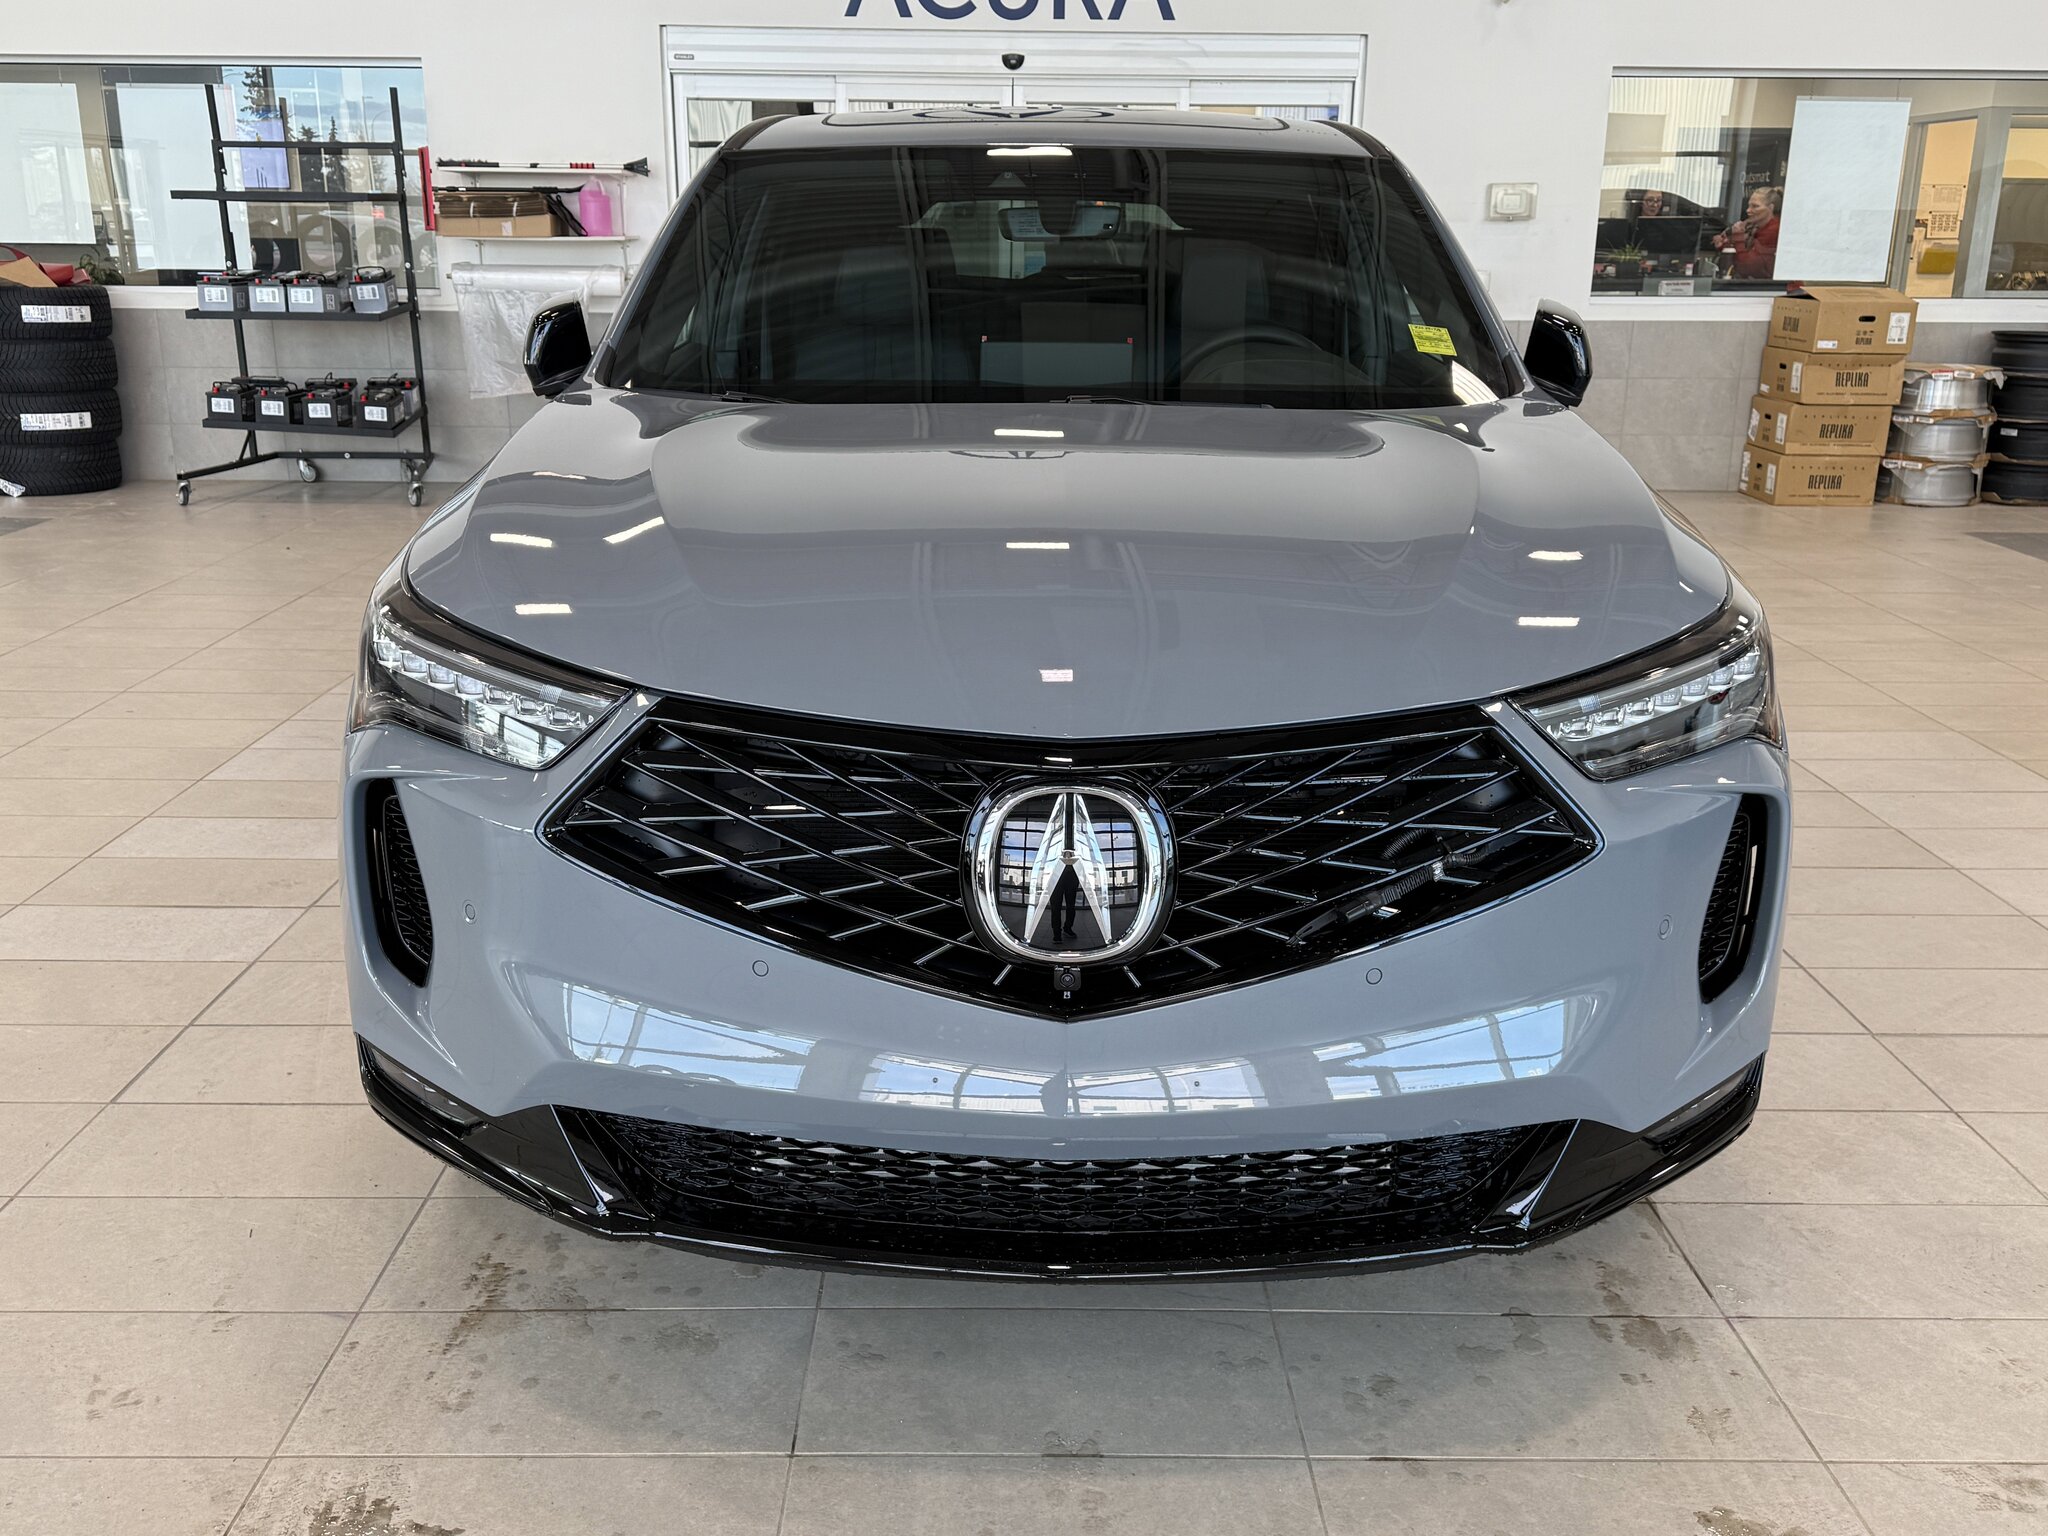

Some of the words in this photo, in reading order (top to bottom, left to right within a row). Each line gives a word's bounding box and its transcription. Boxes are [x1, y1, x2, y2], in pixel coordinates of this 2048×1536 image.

[1835, 371, 1870, 388] REPLIKA
[1819, 423, 1854, 440] REPLIKA
[1807, 474, 1843, 490] REPLIKA
